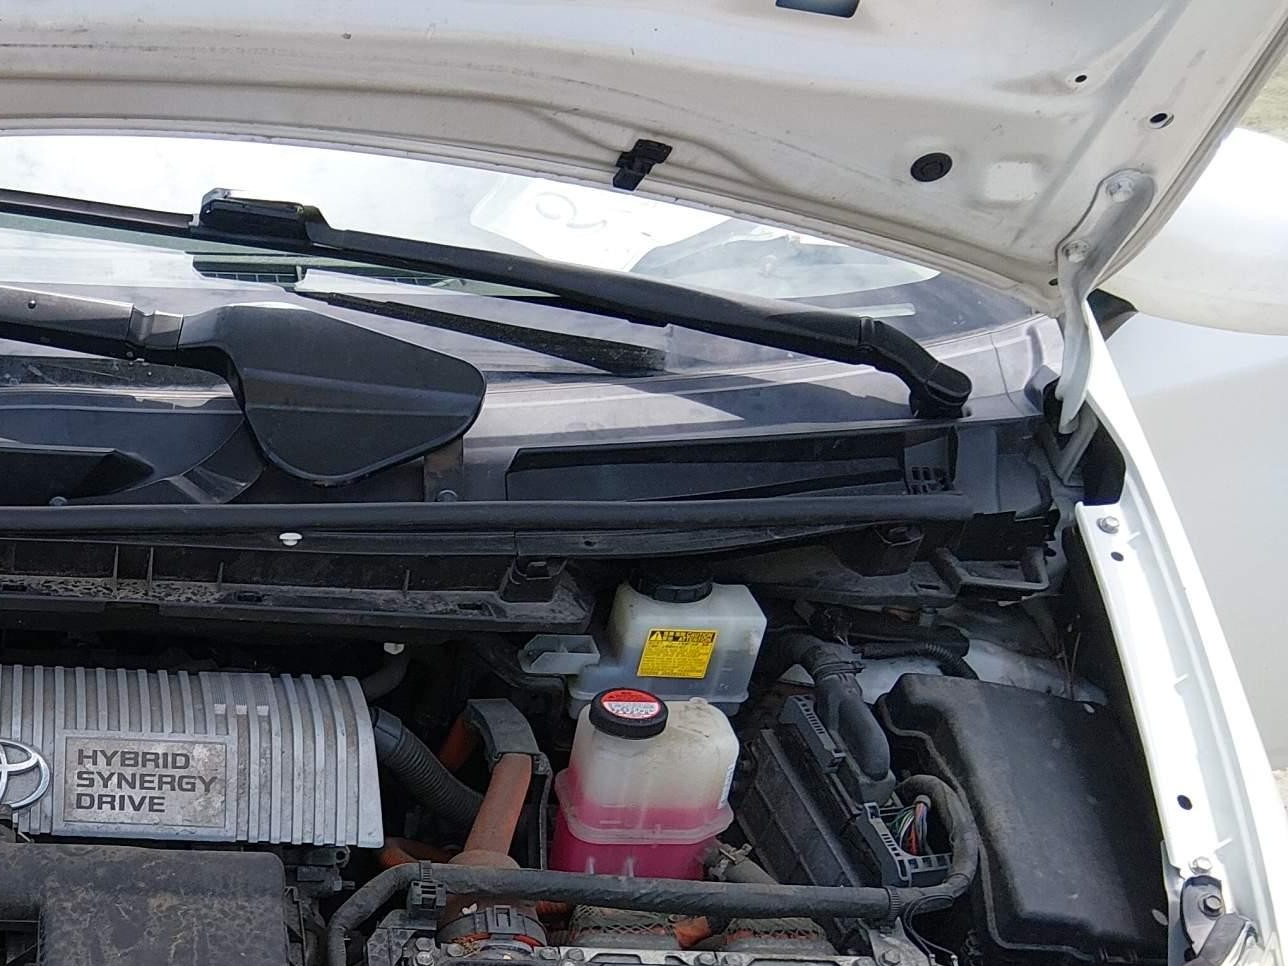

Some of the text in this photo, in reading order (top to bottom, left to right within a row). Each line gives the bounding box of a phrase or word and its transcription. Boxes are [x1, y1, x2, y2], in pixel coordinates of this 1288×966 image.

[77, 749, 190, 770] HYBRID
[76, 770, 218, 793] SYNERGY
[75, 792, 166, 813] DRIVE
